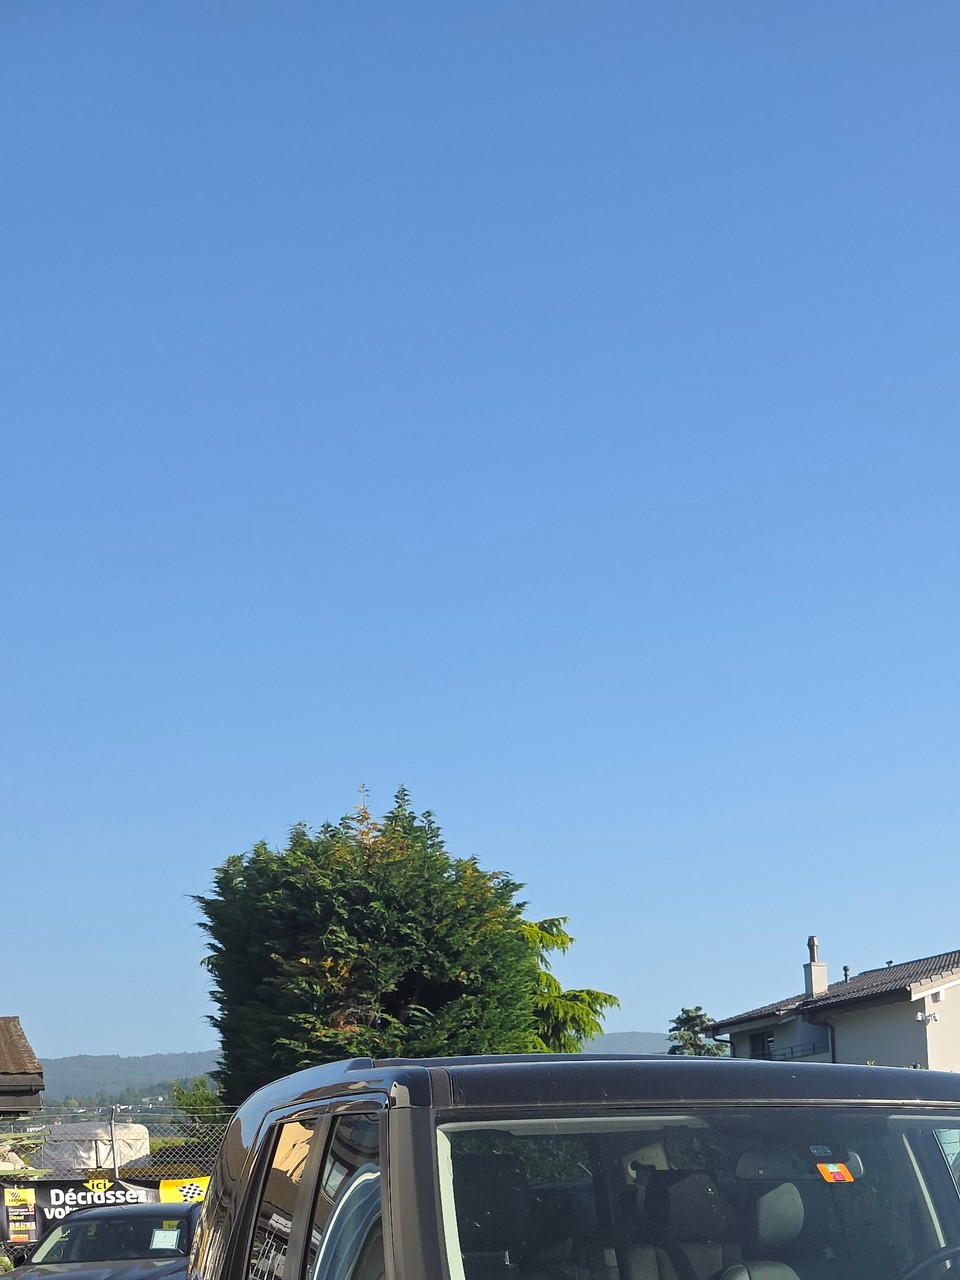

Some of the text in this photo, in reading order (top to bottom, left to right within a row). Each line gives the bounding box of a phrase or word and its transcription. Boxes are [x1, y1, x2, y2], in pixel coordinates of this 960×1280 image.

[91, 1180, 107, 1190] ici
[50, 1188, 148, 1206] Décrassez
[43, 1206, 80, 1220] vot
